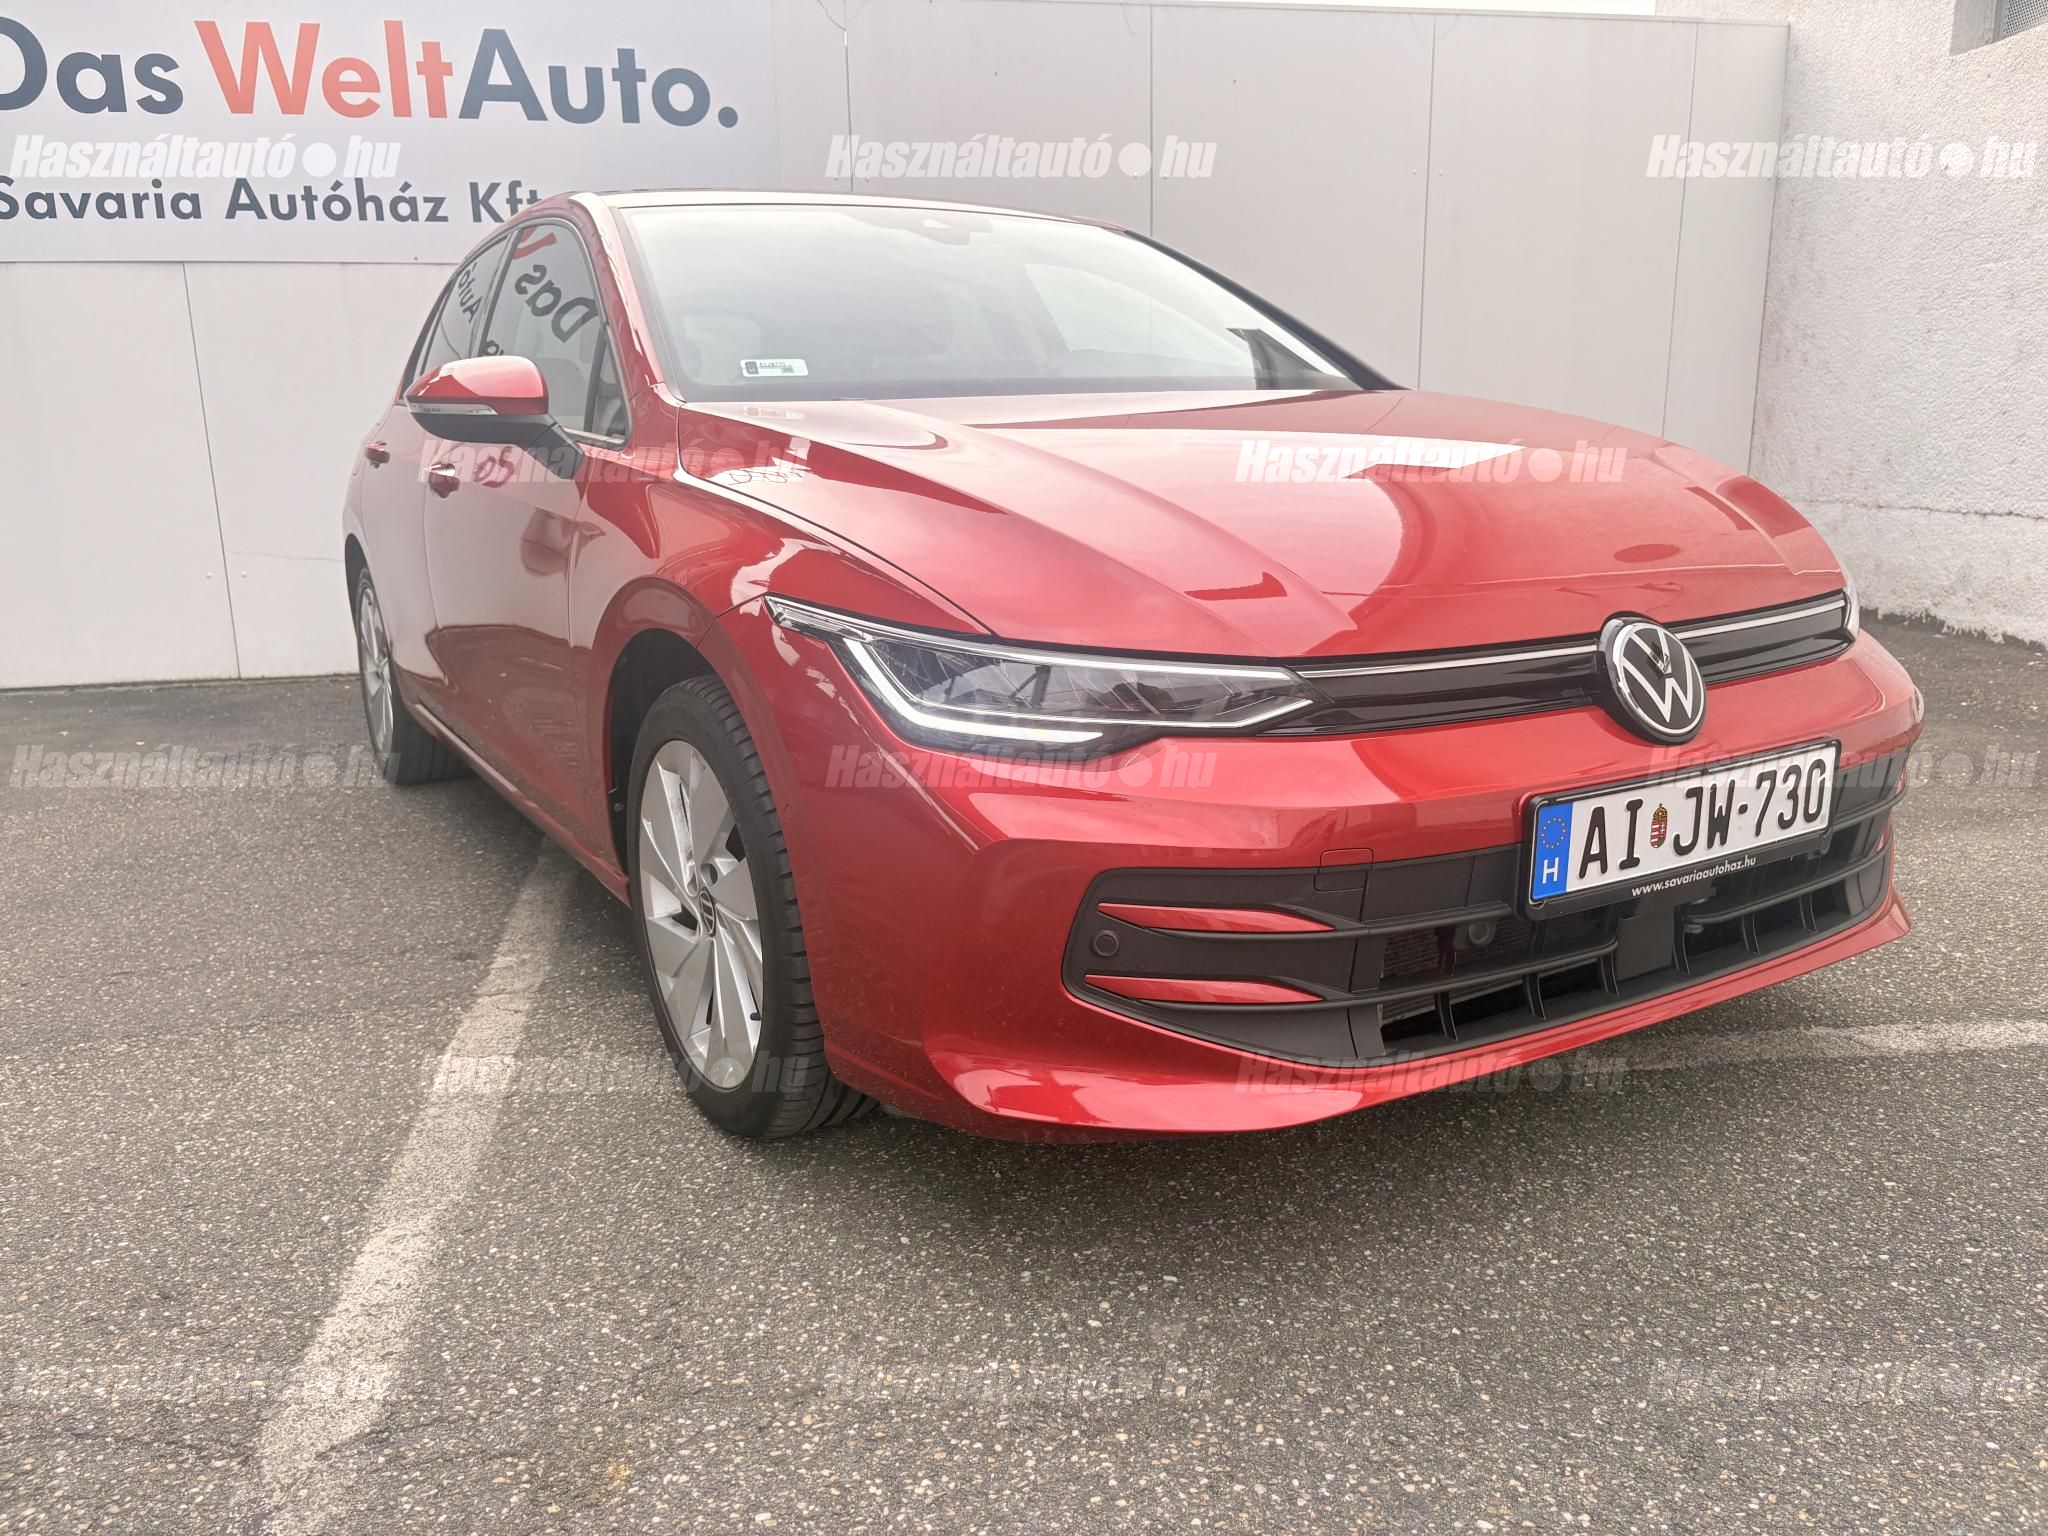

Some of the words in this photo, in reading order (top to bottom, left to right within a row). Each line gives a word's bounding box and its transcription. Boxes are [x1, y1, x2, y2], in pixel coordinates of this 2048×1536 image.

[194, 20, 739, 128] WeltAuto.
[0, 175, 203, 220] Savaria
[225, 177, 449, 223] Autóház
[1541, 857, 1559, 884] H
[1631, 855, 1757, 897] www.savariaautohaz.hu
